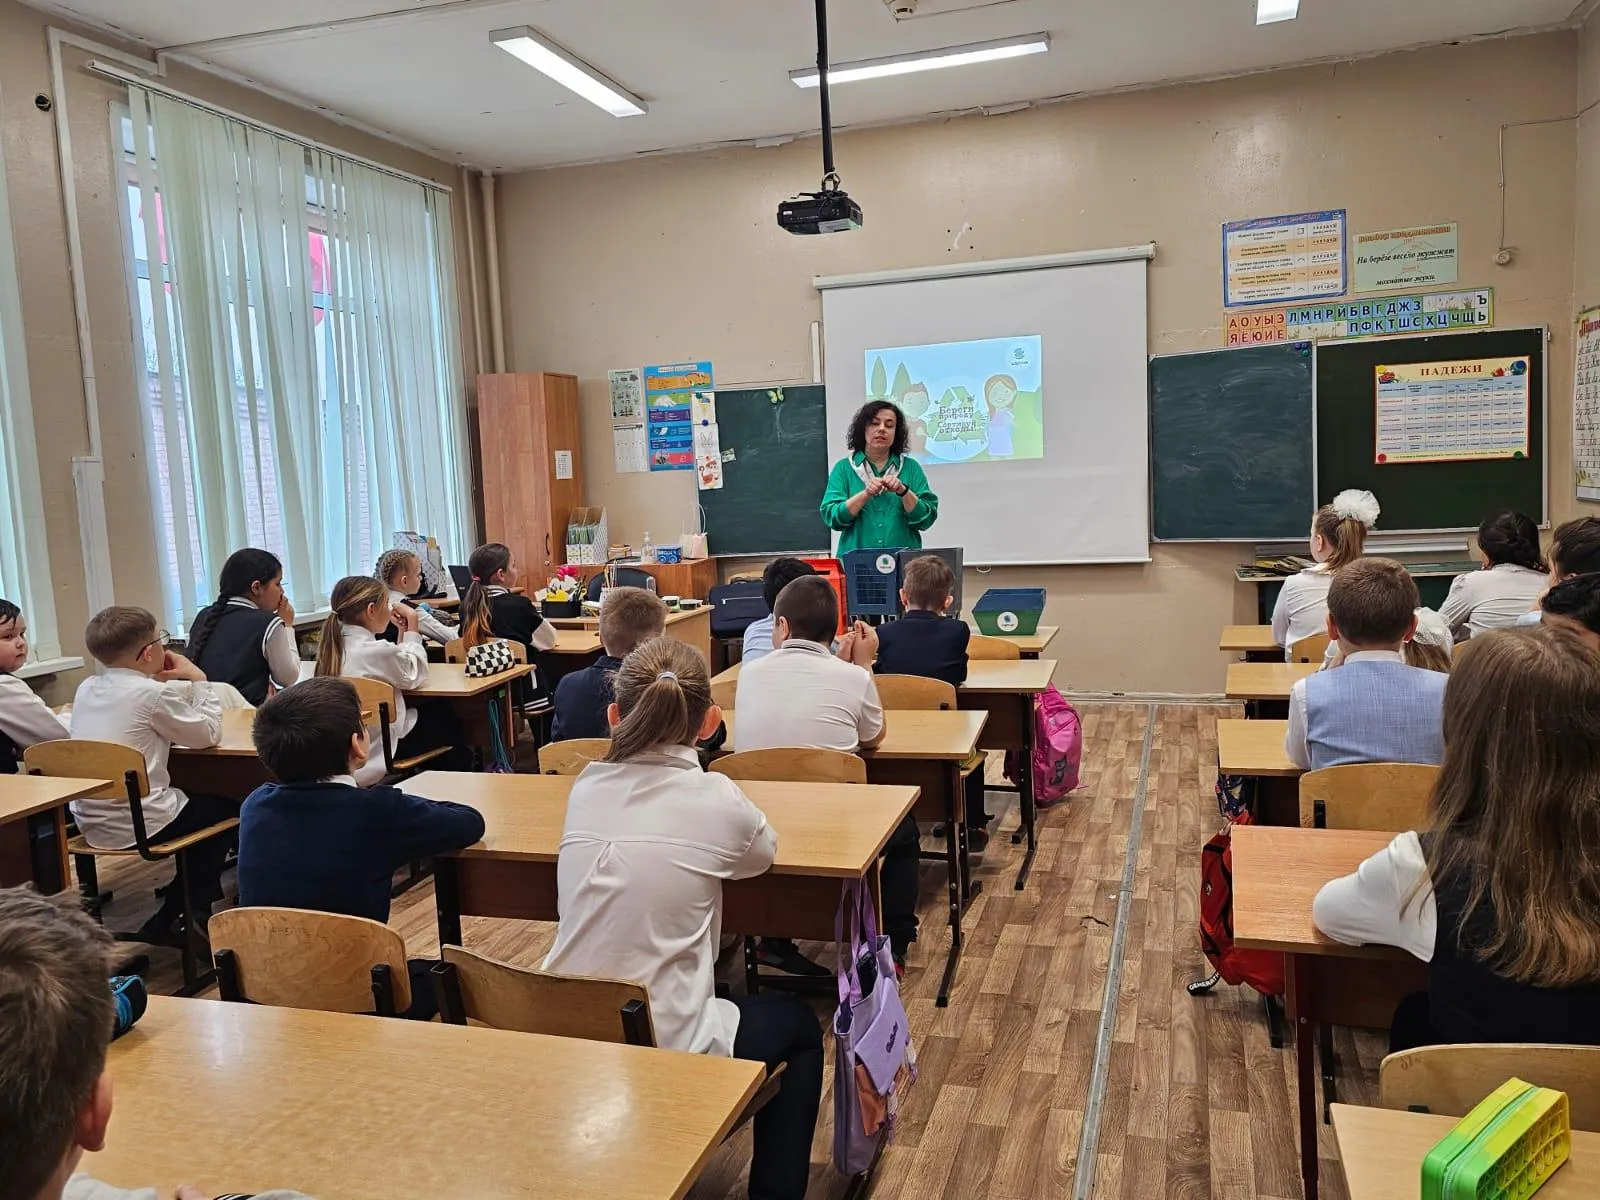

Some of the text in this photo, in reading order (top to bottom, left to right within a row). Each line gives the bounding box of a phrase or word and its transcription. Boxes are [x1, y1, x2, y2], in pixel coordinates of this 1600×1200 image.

[1357, 248, 1455, 264] На берёзе весело жужжат
[1420, 364, 1482, 377] ПАДЕЖИ
[939, 406, 974, 414] Береги
